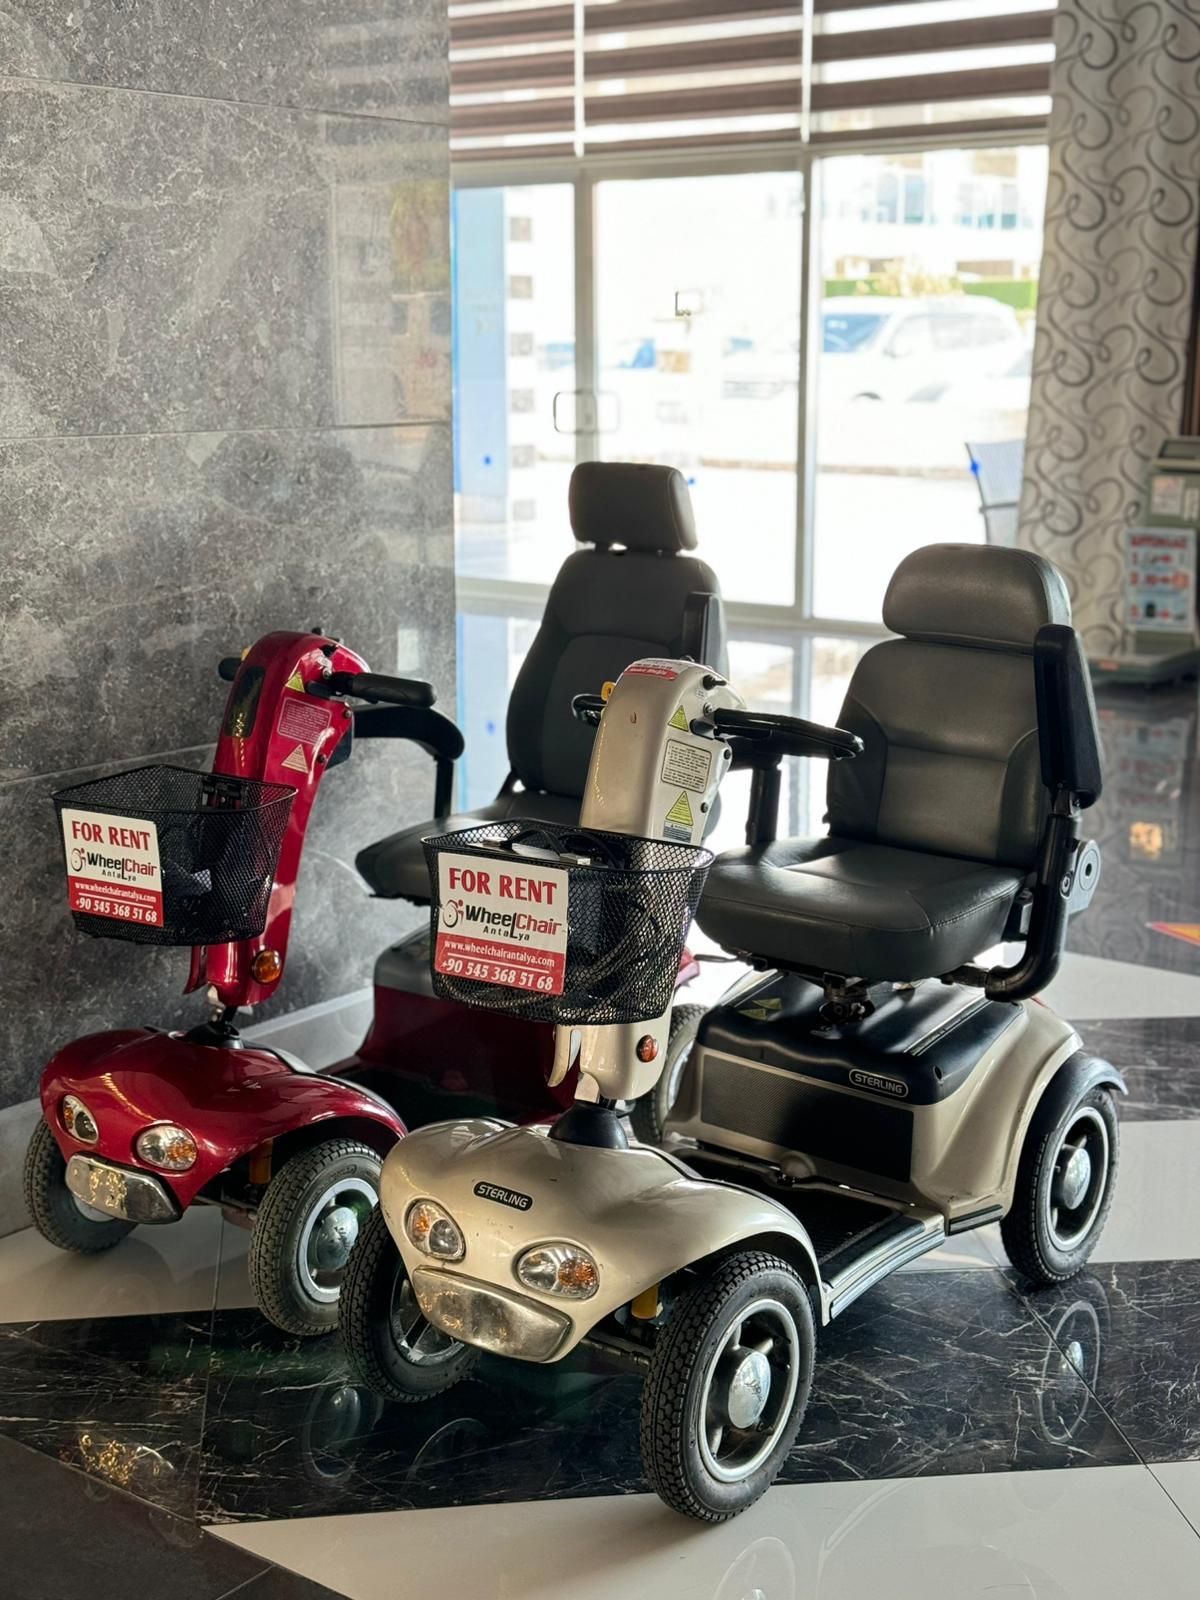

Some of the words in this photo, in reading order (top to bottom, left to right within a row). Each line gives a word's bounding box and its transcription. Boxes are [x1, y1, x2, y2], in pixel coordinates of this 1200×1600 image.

[72, 820, 104, 844] FOR
[108, 826, 150, 851] RENT
[448, 867, 491, 896] FOR
[499, 874, 558, 905] RENT
[76, 897, 92, 910] +90
[93, 900, 110, 914] 545
[113, 903, 130, 918] 368
[132, 907, 143, 920] 51
[145, 909, 157, 923] 68
[444, 940, 555, 967] www.wheelchairantalya.com
[441, 958, 463, 973] +90
[465, 962, 488, 978] 545
[491, 966, 516, 984] 368
[518, 971, 534, 987] 51
[536, 976, 554, 991] 68
[855, 1073, 904, 1094] STERLING
[477, 1184, 529, 1208] STERLING
